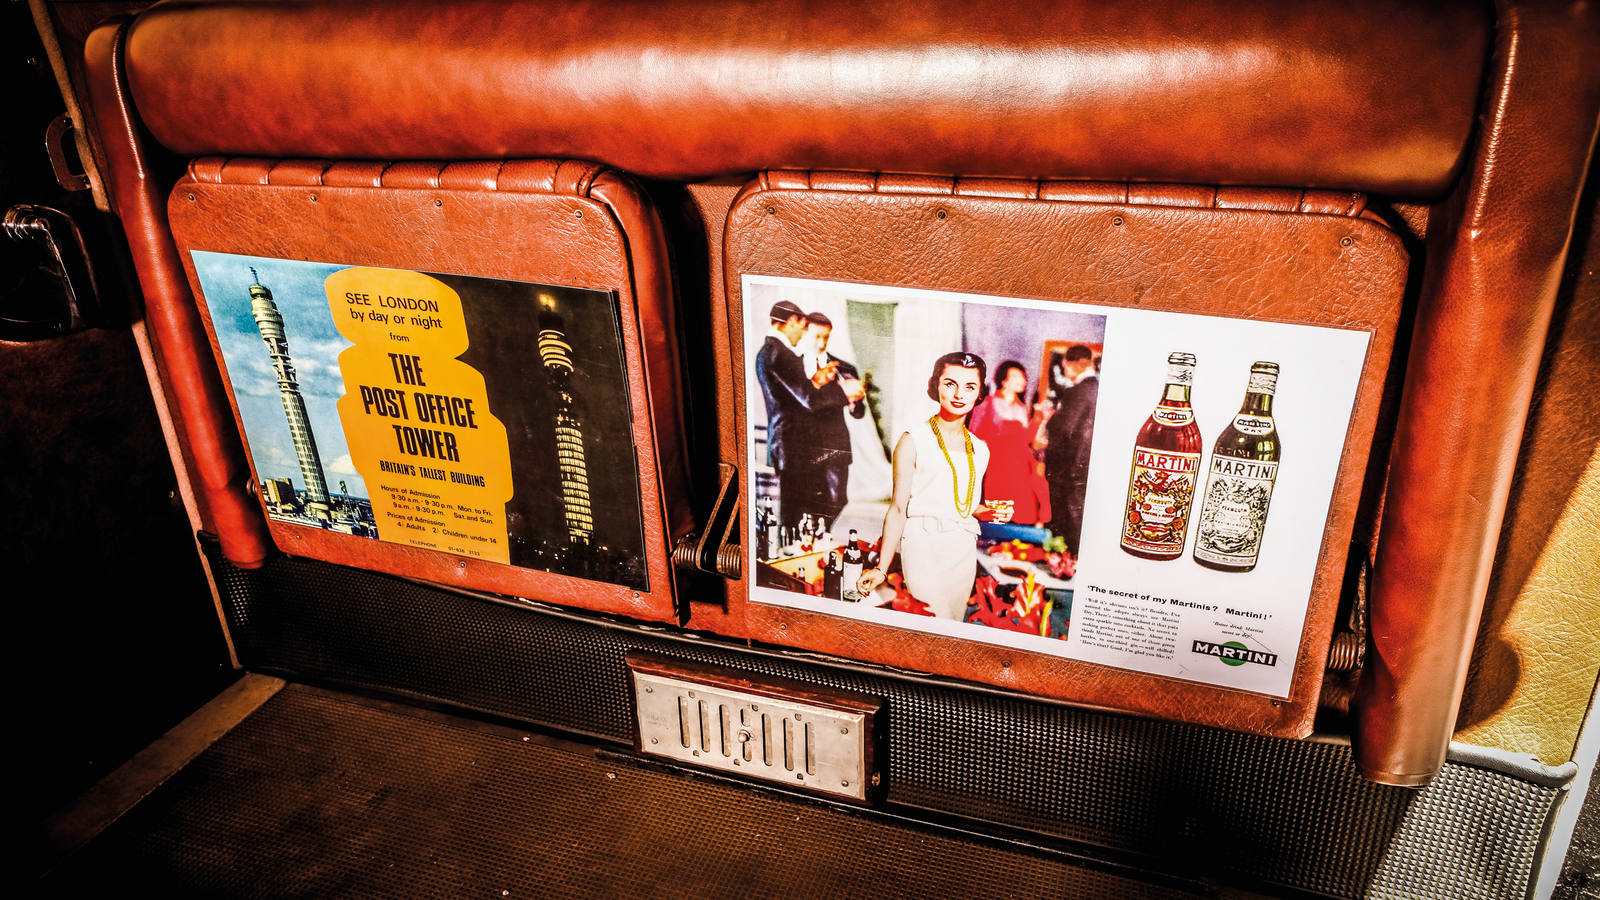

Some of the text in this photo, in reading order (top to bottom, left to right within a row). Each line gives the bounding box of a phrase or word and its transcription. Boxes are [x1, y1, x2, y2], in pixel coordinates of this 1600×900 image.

[346, 293, 438, 312] SEE LONDON
[350, 309, 442, 329] by day or night
[390, 333, 409, 342] from
[388, 353, 426, 386] THE
[360, 385, 478, 429] POST OFFICE
[392, 425, 460, 462] TOWER
[1137, 454, 1195, 471] MARTINI
[1214, 459, 1275, 480] MARTINI
[380, 461, 485, 487] BRITAIN'S TALLEST BUILDING
[410, 490, 440, 499] Admission
[458, 505, 474, 513] Mon.
[387, 512, 405, 520] Prices
[415, 517, 446, 526] Admission
[409, 539, 436, 548] TELEPHONE
[442, 529, 468, 539] Children
[1088, 585, 1106, 594] 'The
[1109, 590, 1138, 599] secret
[1153, 597, 1167, 605] my
[1195, 642, 1274, 665] MARTINI
